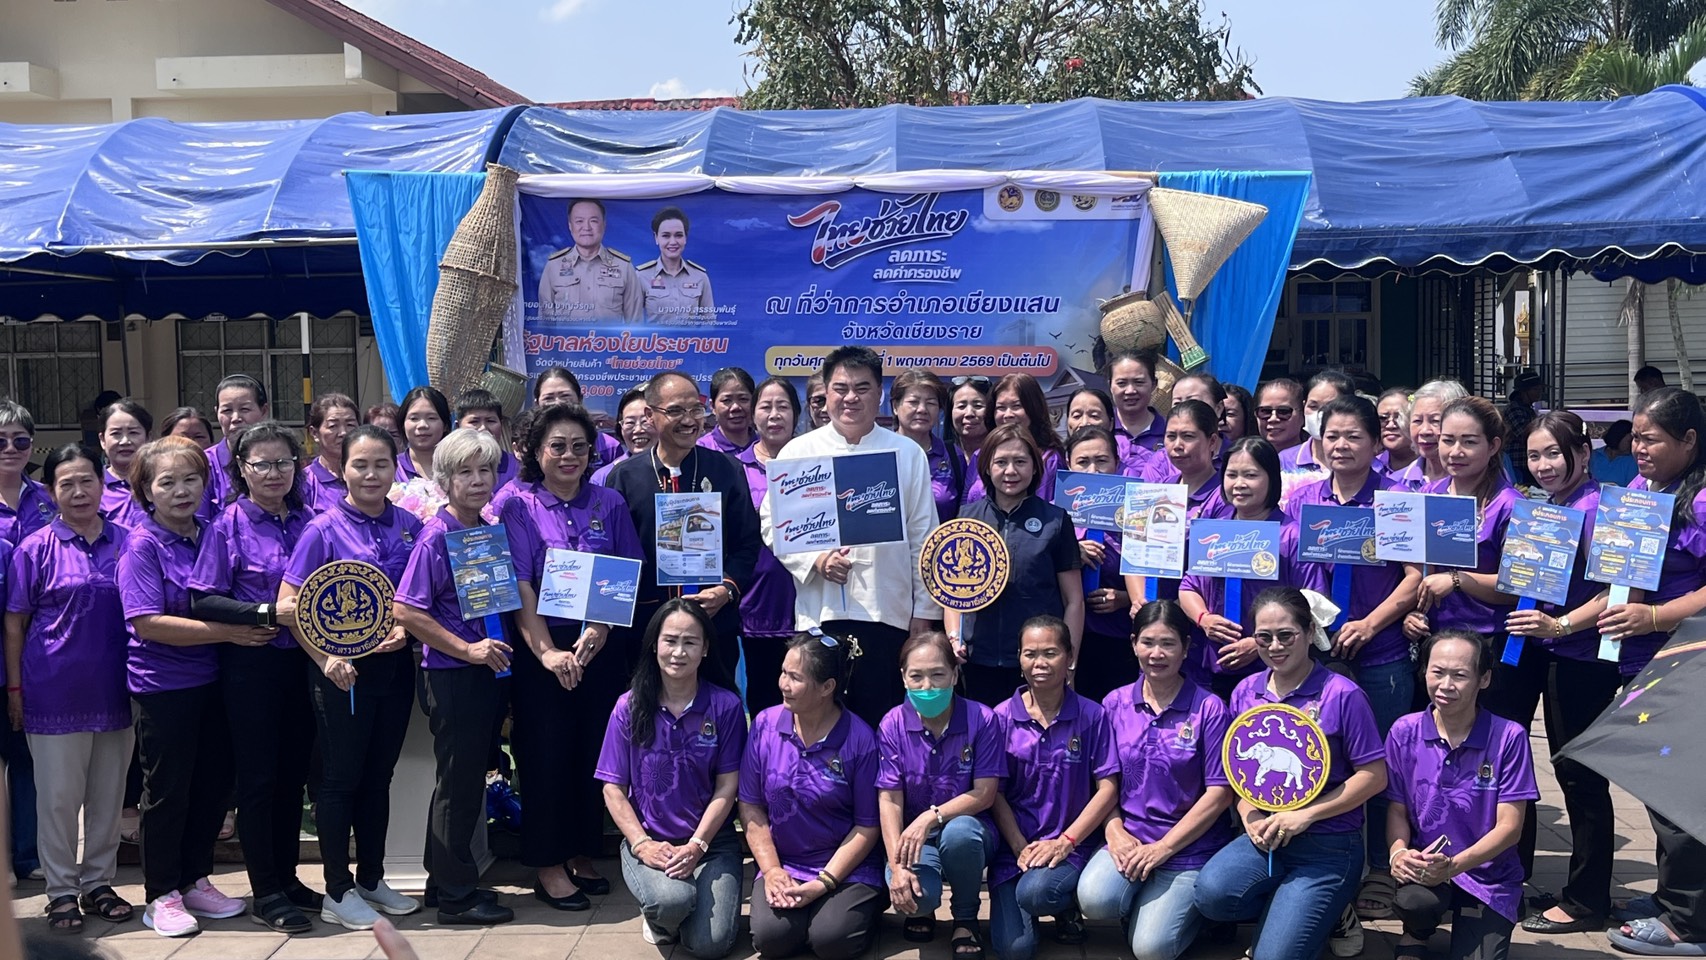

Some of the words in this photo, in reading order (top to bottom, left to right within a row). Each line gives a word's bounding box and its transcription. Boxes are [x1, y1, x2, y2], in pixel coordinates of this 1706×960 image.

[787, 192, 969, 265] ไทยช่วยไทย
[888, 248, 947, 263] ลดภาระ
[873, 266, 962, 281] ลดค่าครองชีพ
[766, 295, 790, 314] ณ
[796, 284, 1061, 314] ที่ว่าการอำเภอเชียงแสน
[842, 321, 983, 340] จังหวัดเชียงราย
[774, 354, 826, 371] ทุกวันศุก
[895, 355, 957, 370] พฤษภาคม
[960, 356, 994, 367] 2569
[997, 352, 1051, 367] เป็นต้นไป
